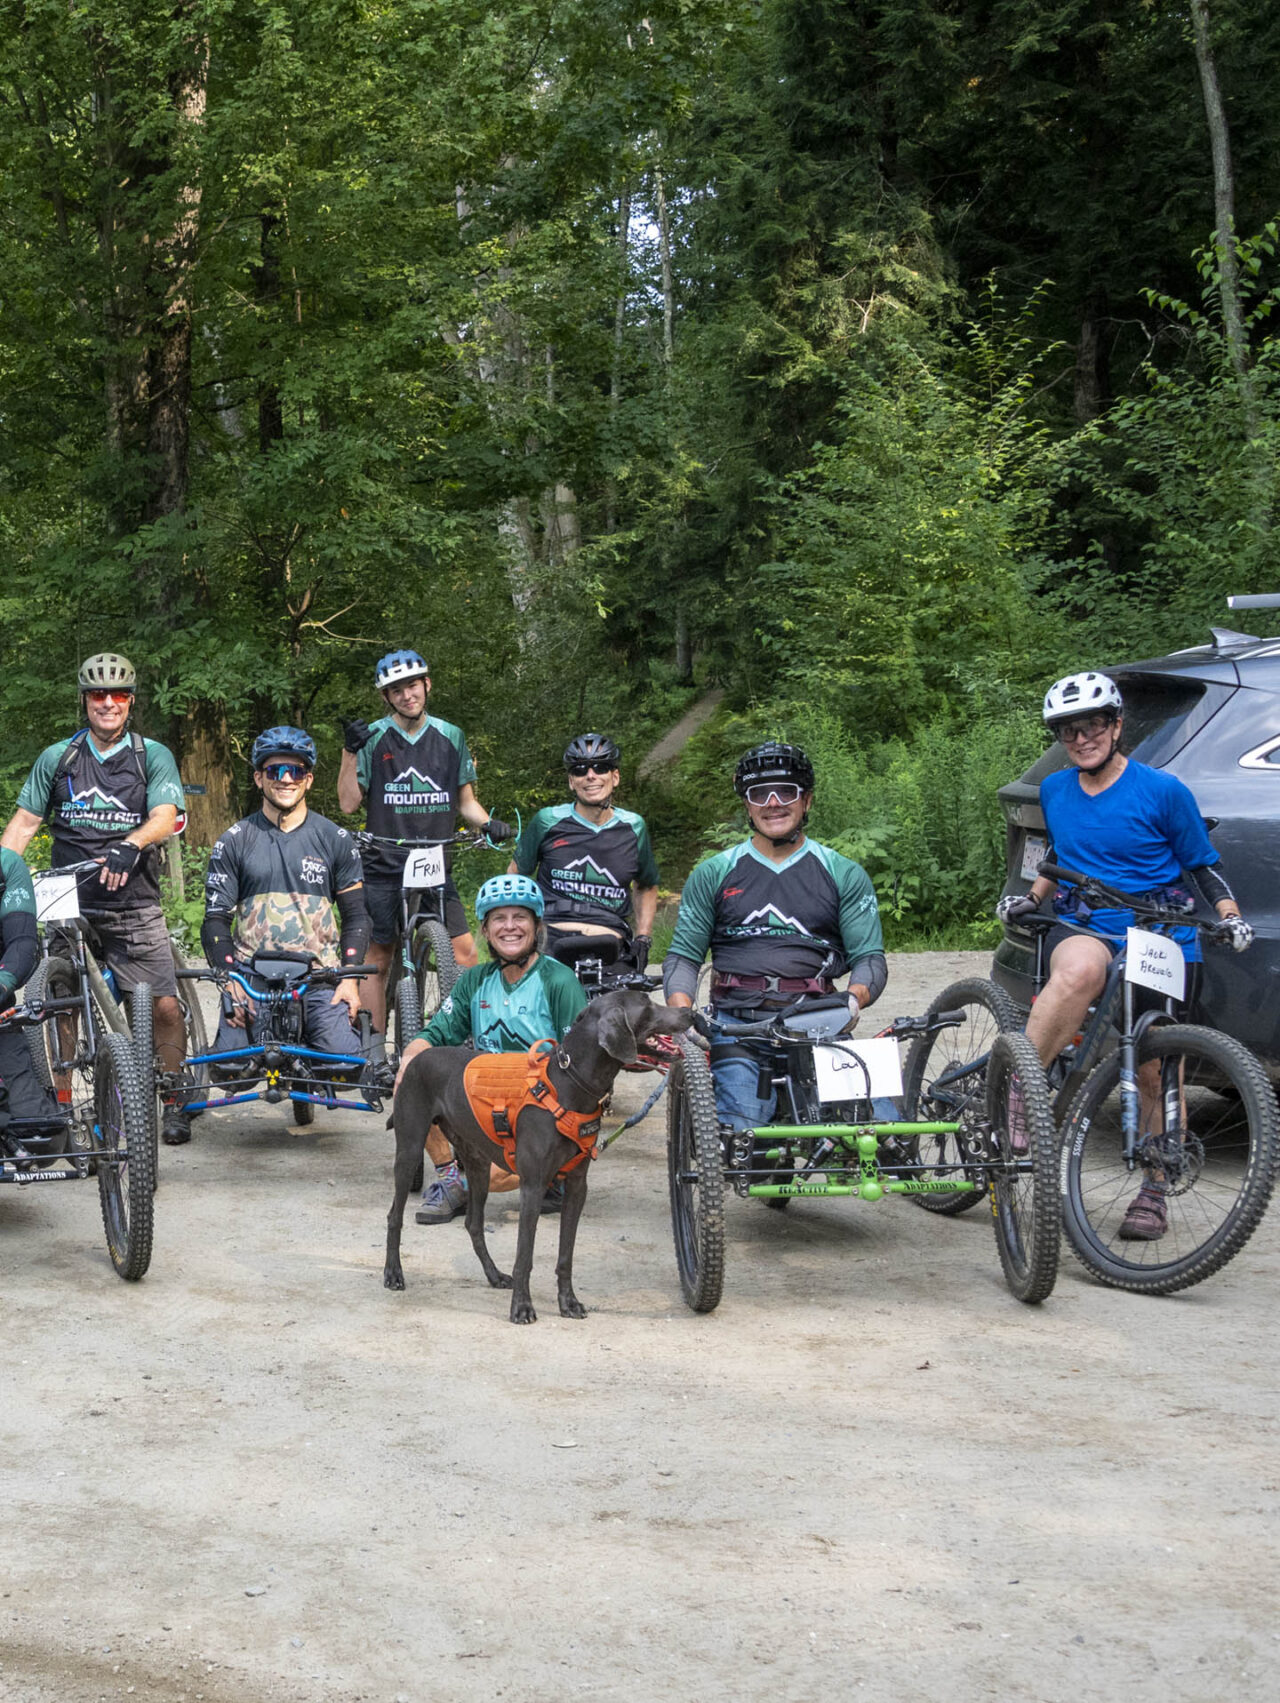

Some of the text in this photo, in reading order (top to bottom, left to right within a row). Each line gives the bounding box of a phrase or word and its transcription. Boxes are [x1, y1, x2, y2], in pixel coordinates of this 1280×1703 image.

[384, 783, 410, 792] GREEN
[384, 792, 450, 804] MOUNTAIN
[412, 857, 440, 878] FRAN
[551, 869, 583, 880] GREEN
[552, 879, 627, 898] MOUNTAIN
[1073, 1132, 1085, 1156] SWISS
[13, 1170, 66, 1182] ADAPTATIONS
